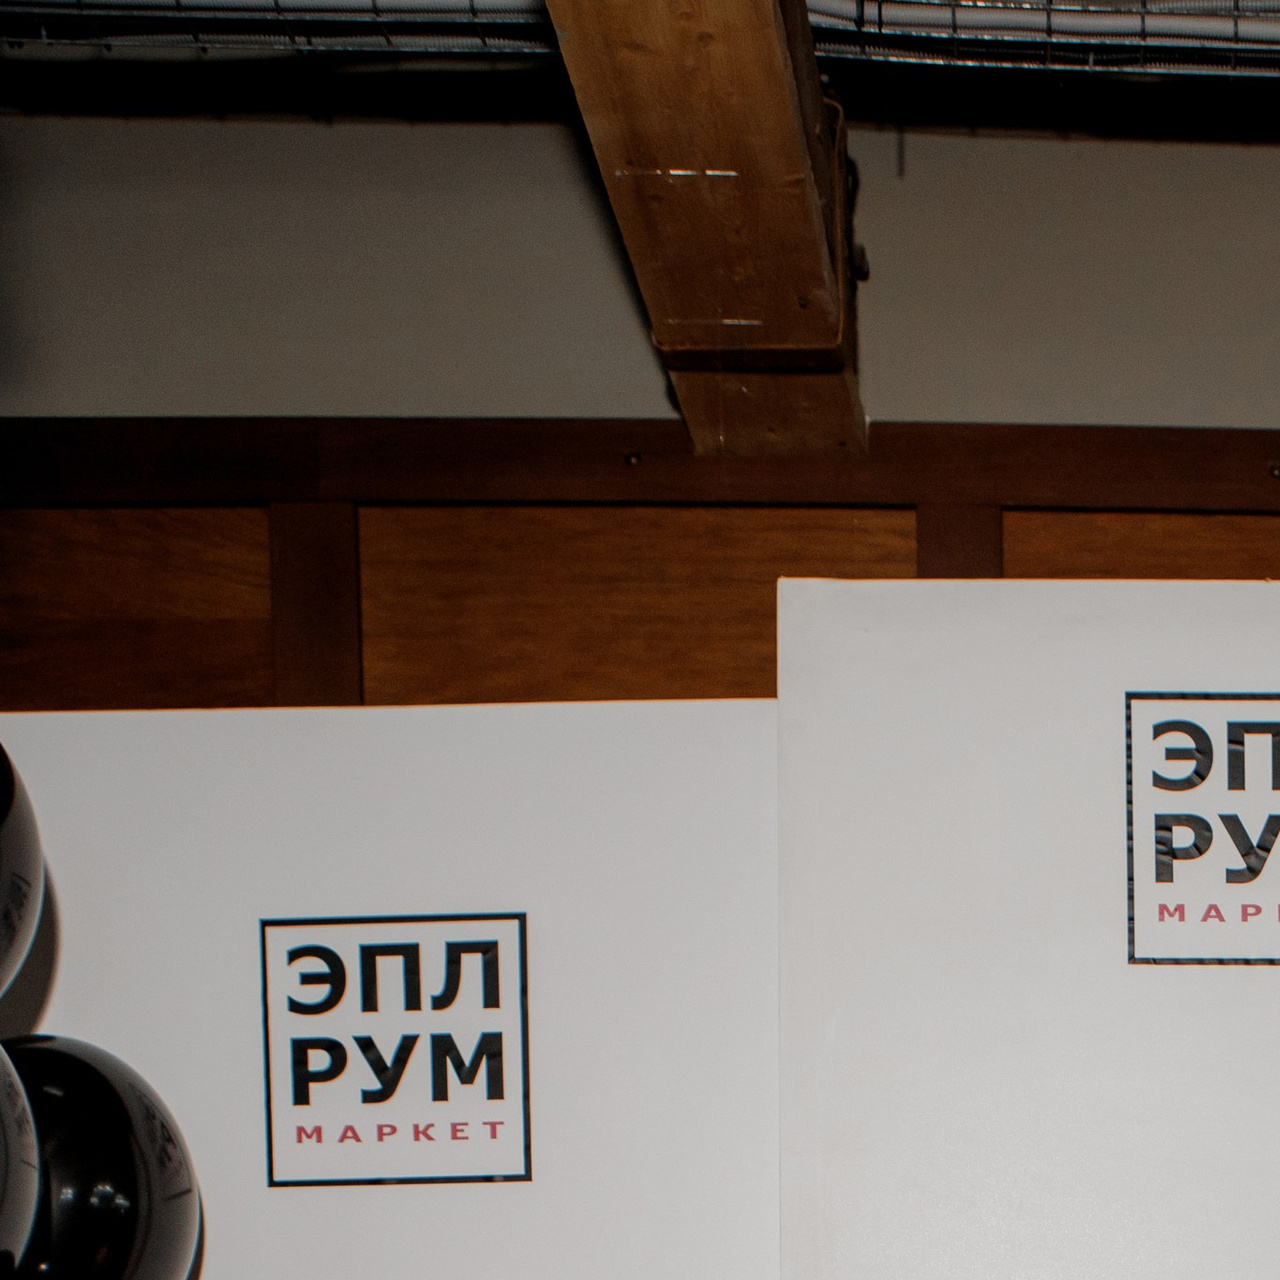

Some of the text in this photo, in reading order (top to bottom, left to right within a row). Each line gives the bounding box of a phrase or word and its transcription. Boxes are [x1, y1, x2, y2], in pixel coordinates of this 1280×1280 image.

[286, 939, 501, 1015] ЭПЛ
[290, 1031, 504, 1106] РУМ
[295, 1121, 504, 1144] МАРКЕТ
